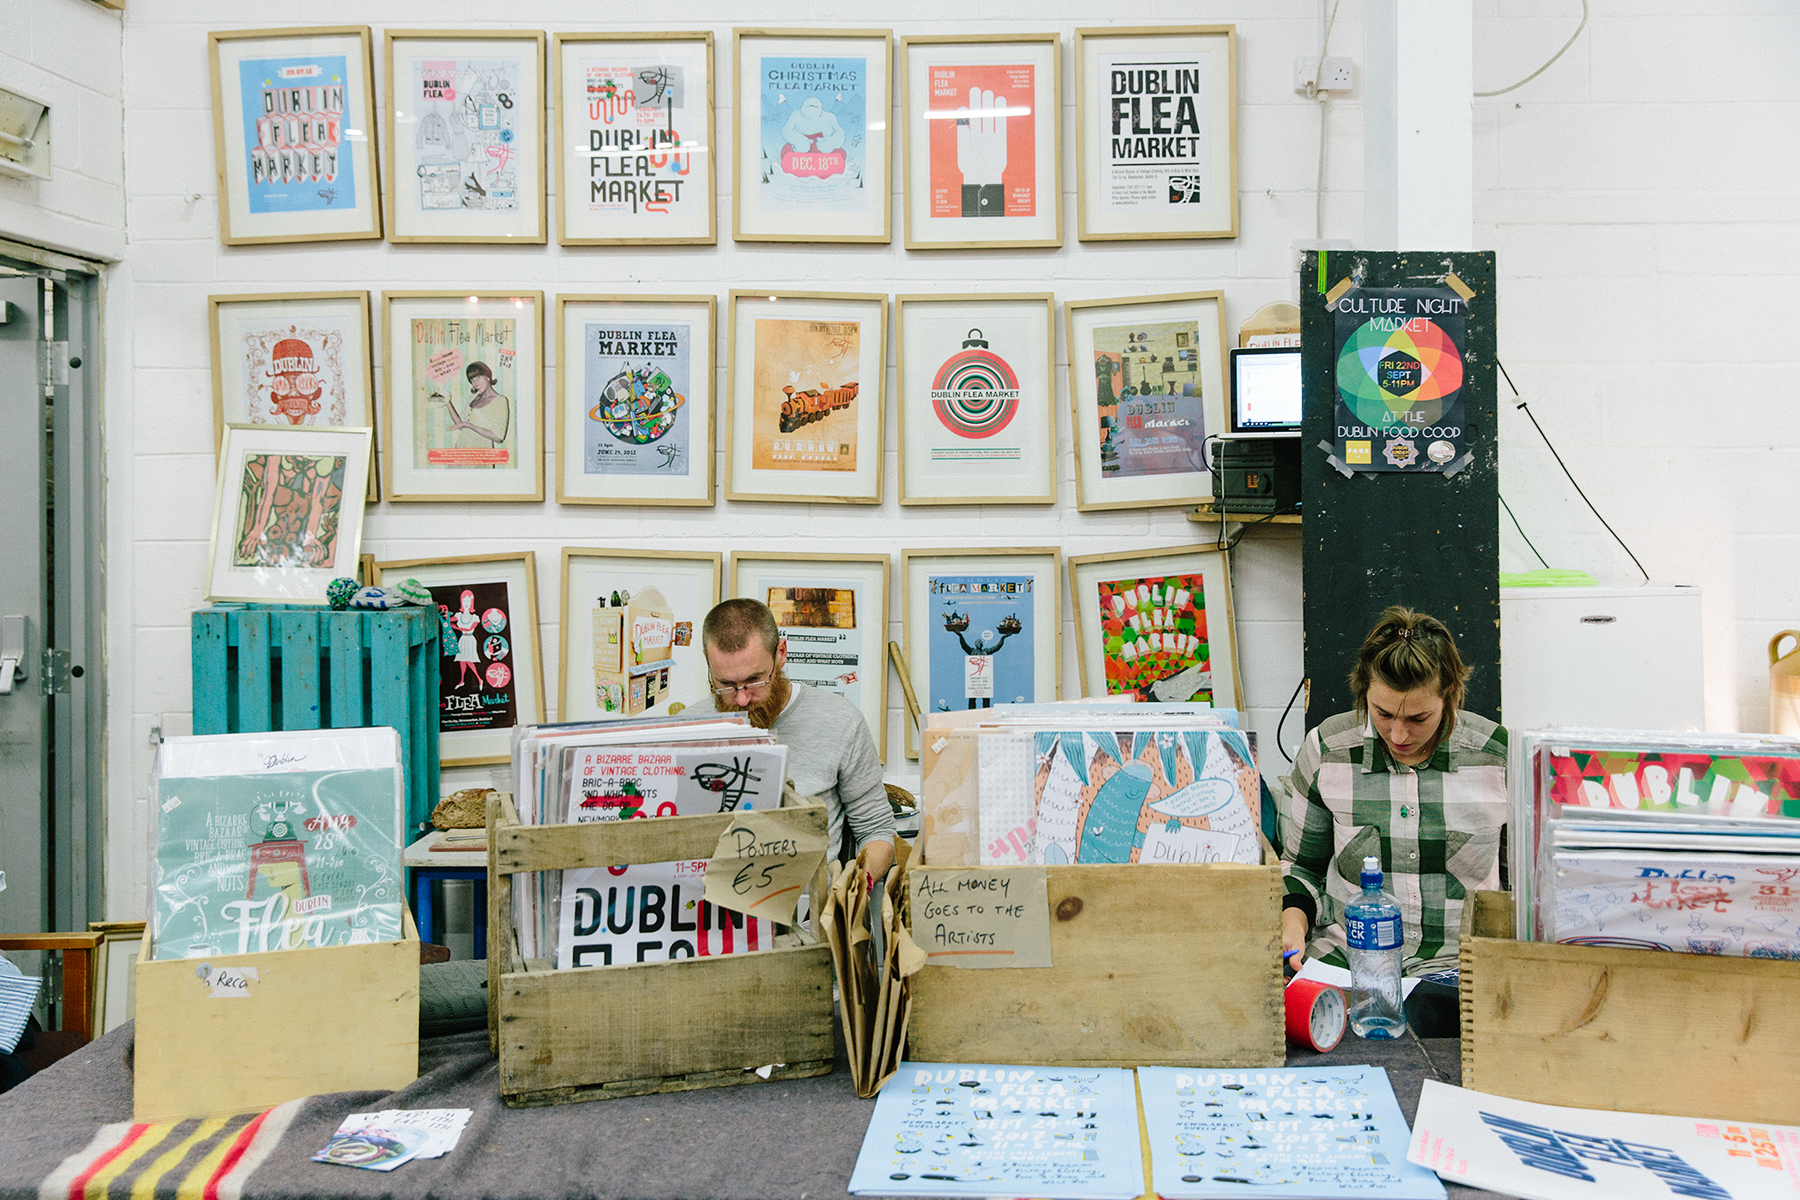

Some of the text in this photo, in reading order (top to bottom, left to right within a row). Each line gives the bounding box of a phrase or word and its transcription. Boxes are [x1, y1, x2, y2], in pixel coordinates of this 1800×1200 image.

[768, 70, 857, 81] CHRISTMAS
[934, 71, 955, 79] DUBLIN
[1111, 69, 1199, 94] DUBLIN
[423, 80, 450, 88] DUBLIN
[769, 82, 859, 91] FLEA MARKET
[934, 80, 949, 88] FLEA
[423, 90, 443, 98] FLEA
[934, 88, 957, 96] MARKET
[263, 89, 344, 113] DUBLIN
[1112, 96, 1200, 135] FLEA
[272, 122, 326, 151] FLEA
[1112, 137, 1200, 158] MARKET
[253, 154, 337, 179] MARKET
[591, 155, 656, 177] FLEA
[792, 157, 816, 170] DEC.
[591, 180, 684, 214] MARKET
[1338, 299, 1461, 314] CULTURE NIGHT
[1369, 317, 1432, 332] MARKET
[416, 321, 513, 347] Dublin Flea Market
[599, 330, 677, 341] DUBLIN FLEA
[599, 342, 678, 356] MARKET
[273, 357, 315, 374] DUBLIN
[1379, 361, 1420, 370] FRI 22ND
[1386, 371, 1411, 379] SEPT
[1383, 380, 1415, 388] 5-11PM
[1127, 402, 1175, 415] DUBLIN
[1382, 411, 1425, 423] AT THE
[1337, 426, 1461, 438] DUBLIN FOOD COOP
[773, 439, 839, 453] DUBLIN
[1111, 584, 1190, 618] DUBLIN
[444, 693, 484, 711] FLEA
[482, 693, 510, 706] Market
[585, 754, 672, 764] A BIZARRE BAZAAR
[583, 766, 687, 777] OF VINTAGE CLOTHING,
[582, 778, 643, 788] BRIC-A-BRAC
[1578, 765, 1770, 813] DUBLIN
[582, 789, 658, 799] AND WHAT NOTS
[580, 801, 631, 811] THE CO-OP
[205, 812, 248, 827] A BIZARRE
[308, 812, 352, 834] Aug
[209, 826, 242, 839] BAZAAR
[185, 838, 246, 851] VINTAGE CLOTHING
[731, 827, 797, 859] POSTERS
[194, 849, 247, 863] BRIC-A-BRAC
[1153, 841, 1221, 863] Dublin
[217, 875, 244, 892] NOTS
[732, 864, 786, 895] €5
[917, 875, 1011, 898] ALL MONEY
[295, 896, 329, 913] DUBLIN
[573, 884, 743, 936] DUBLIN
[923, 902, 1026, 919] GOES TO THE
[221, 892, 336, 955] Flea
[1345, 918, 1365, 930] VER
[935, 923, 996, 946] ARTISTS
[914, 1069, 1035, 1087] DUBLIN
[1176, 1073, 1297, 1088] DUBLIN
[1000, 1083, 1069, 1097] FLEA
[1266, 1086, 1336, 1098] FLEA
[969, 1096, 1100, 1111] MARKET
[1238, 1097, 1369, 1112] MARKET
[976, 1118, 1023, 1130] SEPT
[1250, 1120, 1302, 1132] SEPT
[991, 1130, 1048, 1142] 2017
[1272, 1132, 1329, 1144] 2017
[1033, 1141, 1049, 1150] 5
[1317, 1143, 1332, 1152] 5
